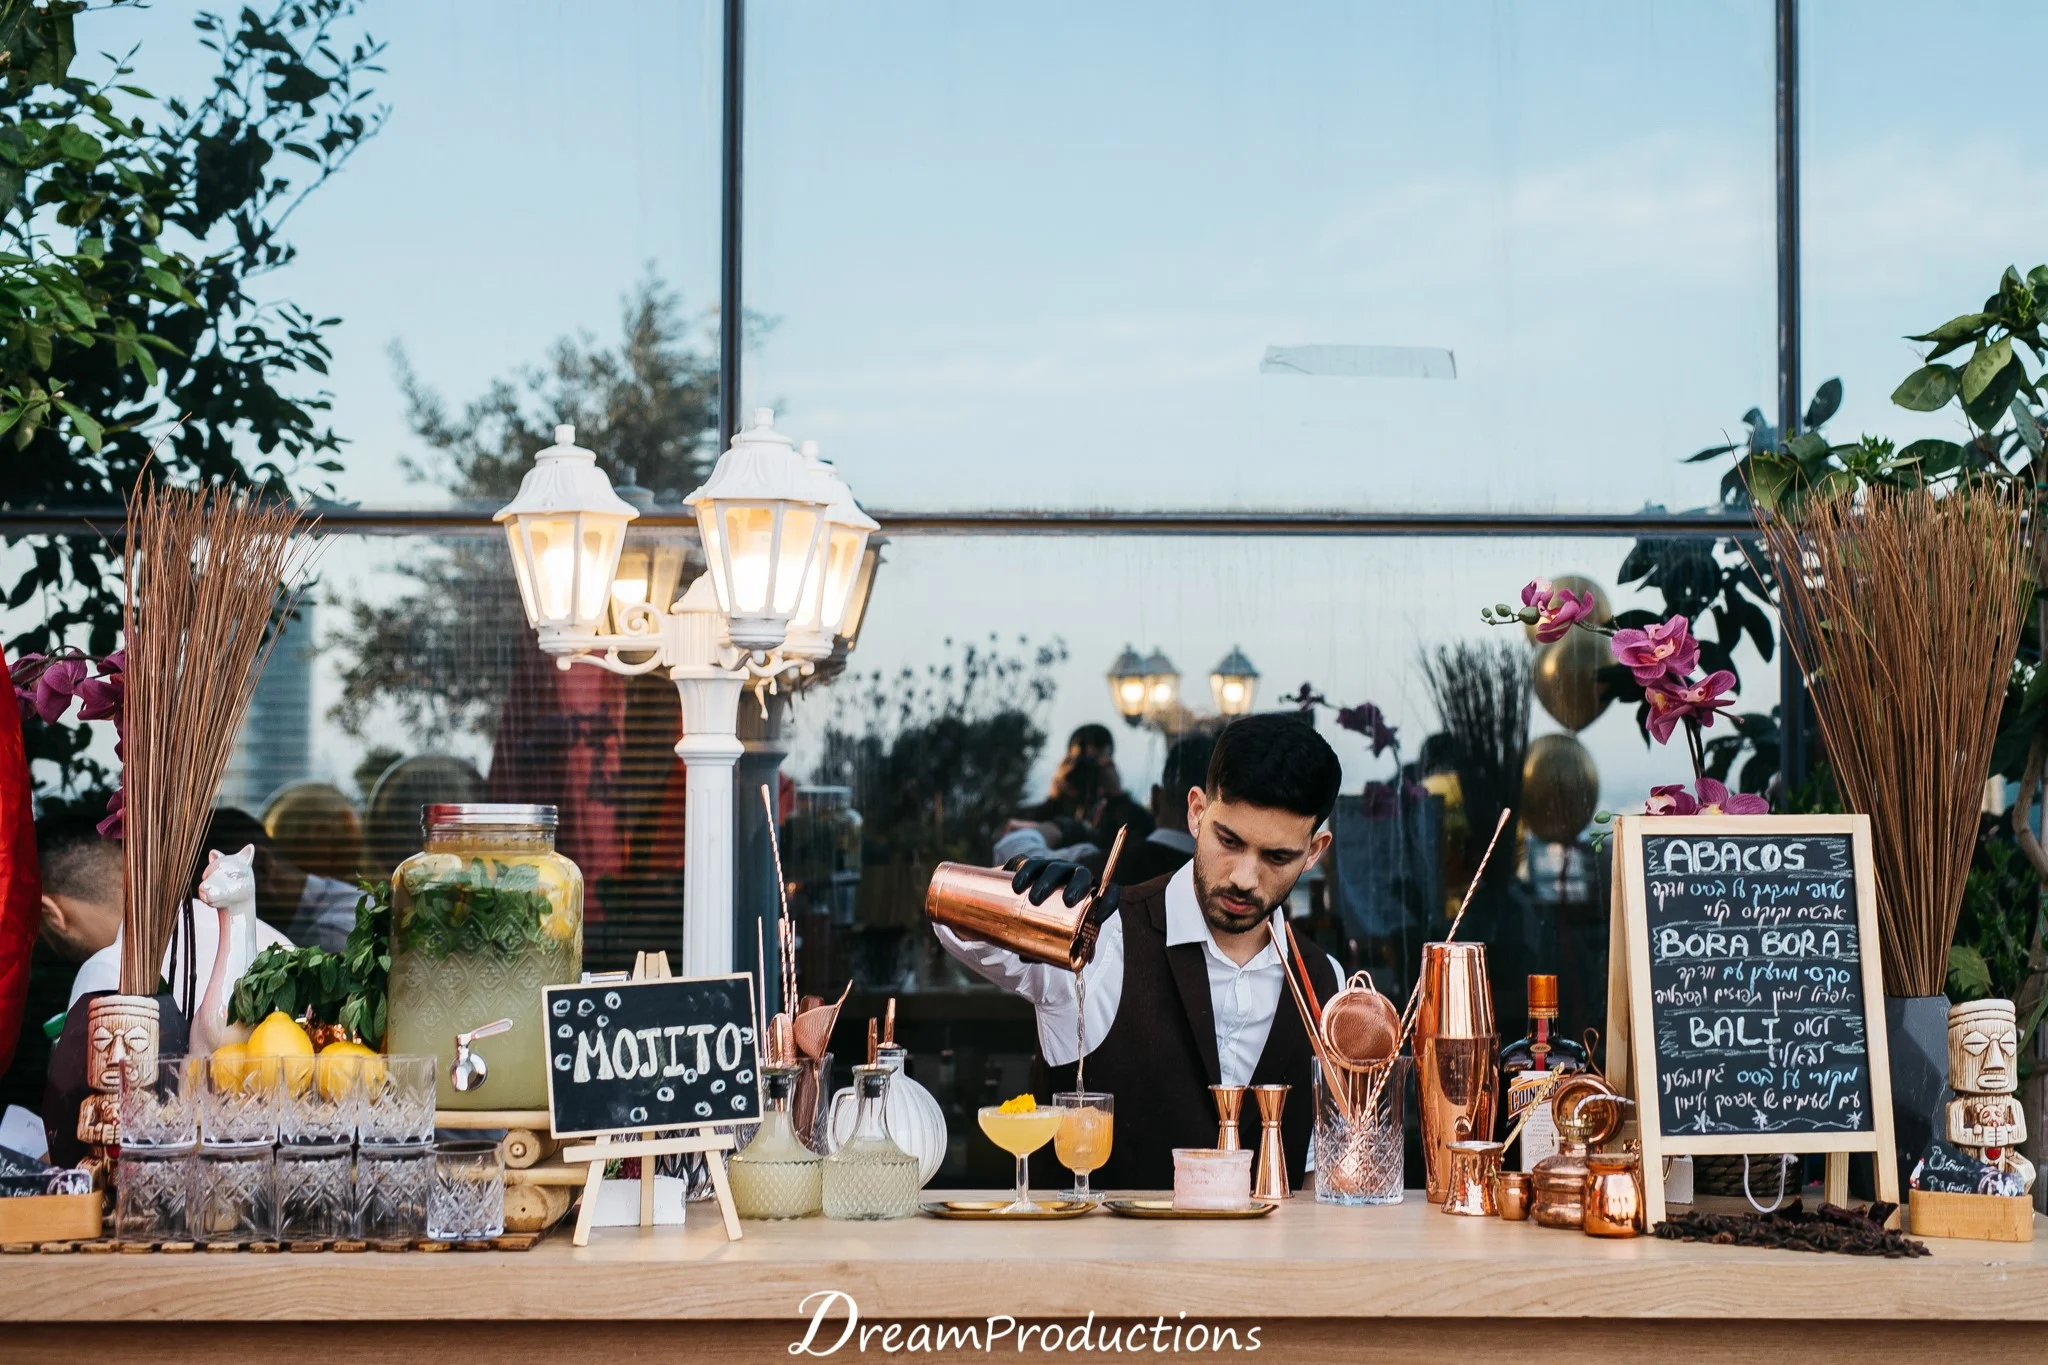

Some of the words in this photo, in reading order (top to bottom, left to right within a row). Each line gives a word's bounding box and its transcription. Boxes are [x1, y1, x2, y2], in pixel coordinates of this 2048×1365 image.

[1664, 840, 1807, 873] ABACOS
[1690, 880, 1726, 897] בסיס
[1733, 877, 1746, 898] על
[1751, 881, 1800, 907] מתקתק
[1806, 879, 1845, 899] טרופי
[1704, 899, 1730, 927] קלוי
[1660, 928, 1749, 959] BORA
[1762, 929, 1840, 959] BORA
[1723, 961, 1743, 981] עם
[1804, 966, 1850, 992] סקסי
[1689, 1016, 1781, 1048] BALI
[573, 1022, 742, 1083] MOJITO
[1737, 1068, 1774, 1087] בסיס
[1782, 1069, 1800, 1090] על
[1809, 1066, 1858, 1105] מקורי
[1714, 1091, 1758, 1118] אפרסק
[1763, 1087, 1778, 1109] של
[1783, 1091, 1829, 1111] טעמים
[1838, 1090, 1860, 1110] עם
